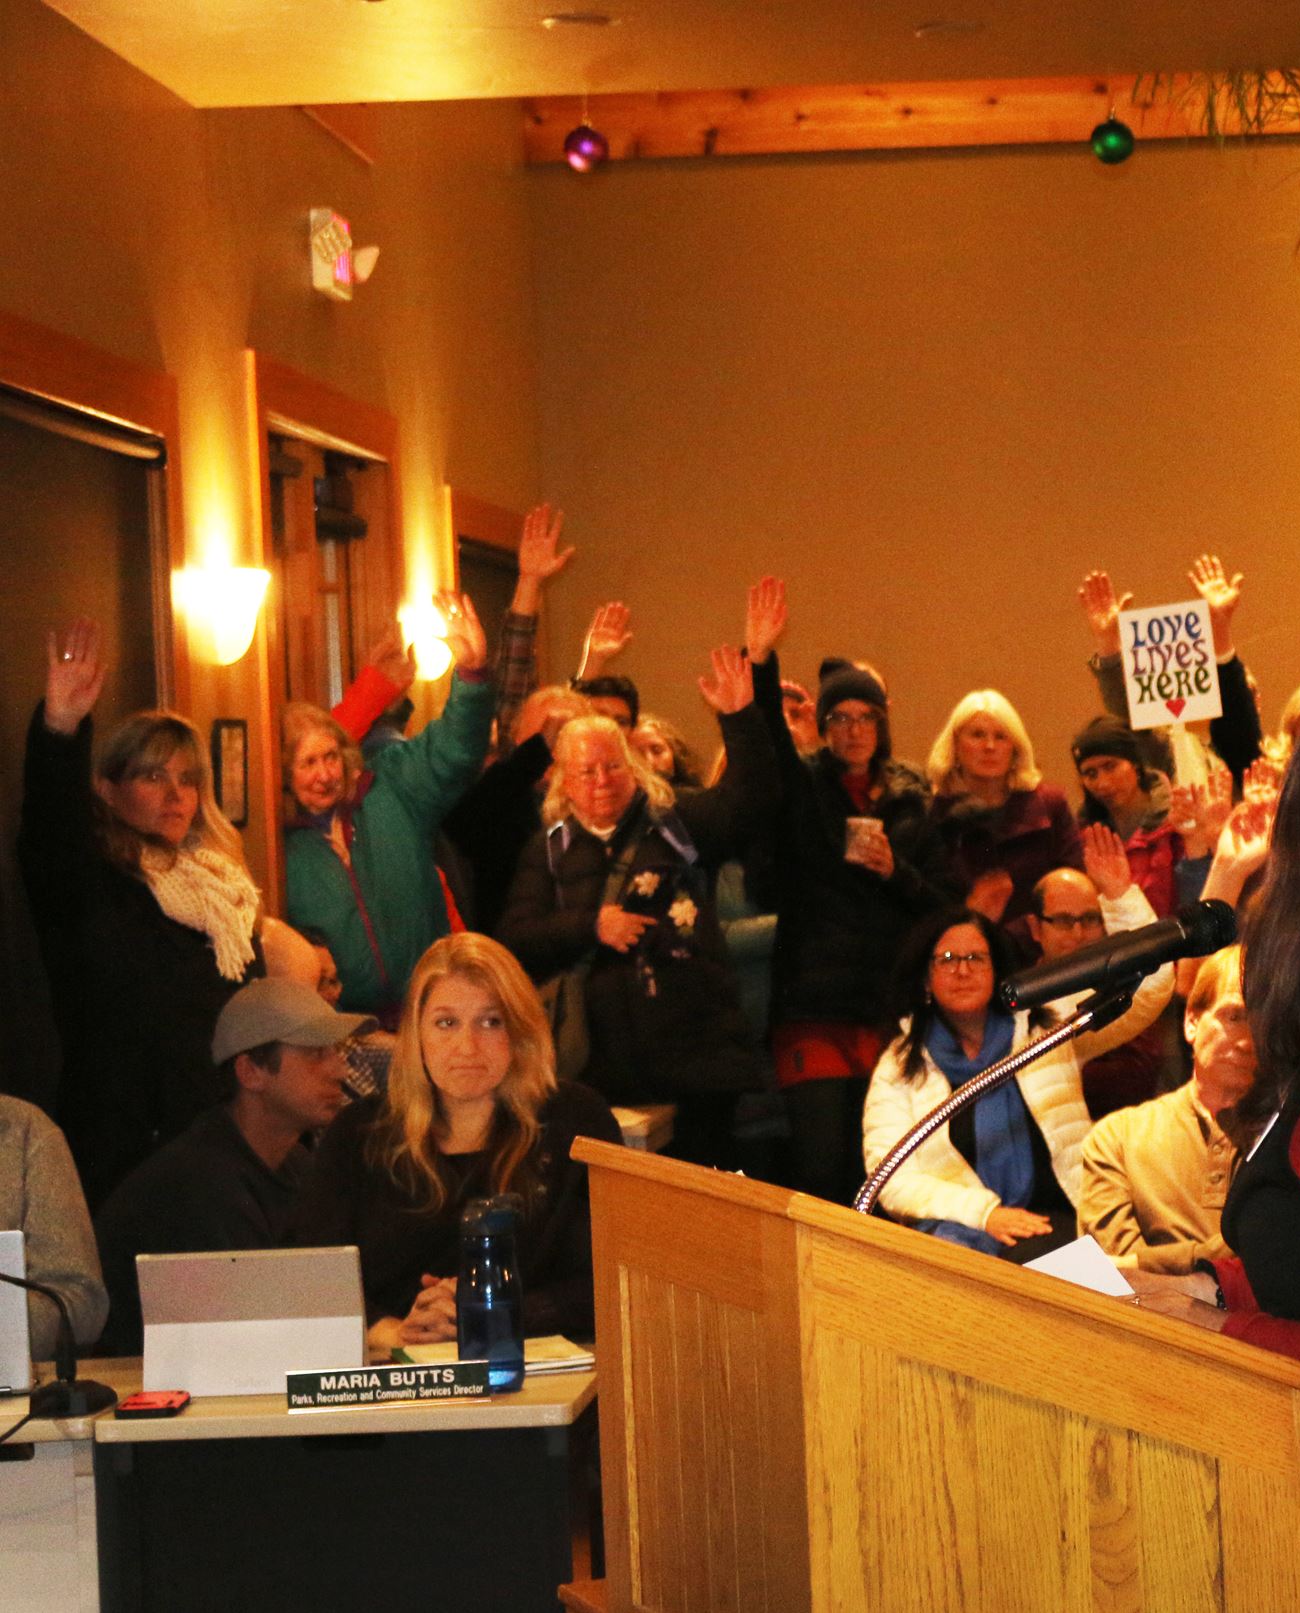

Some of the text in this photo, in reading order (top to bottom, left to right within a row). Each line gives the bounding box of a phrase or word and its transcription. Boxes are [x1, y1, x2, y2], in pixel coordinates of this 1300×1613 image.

[320, 1368, 455, 1390] MARIA BUTTS
[291, 1384, 484, 1405] Parks, Recreation and Community Services Director
